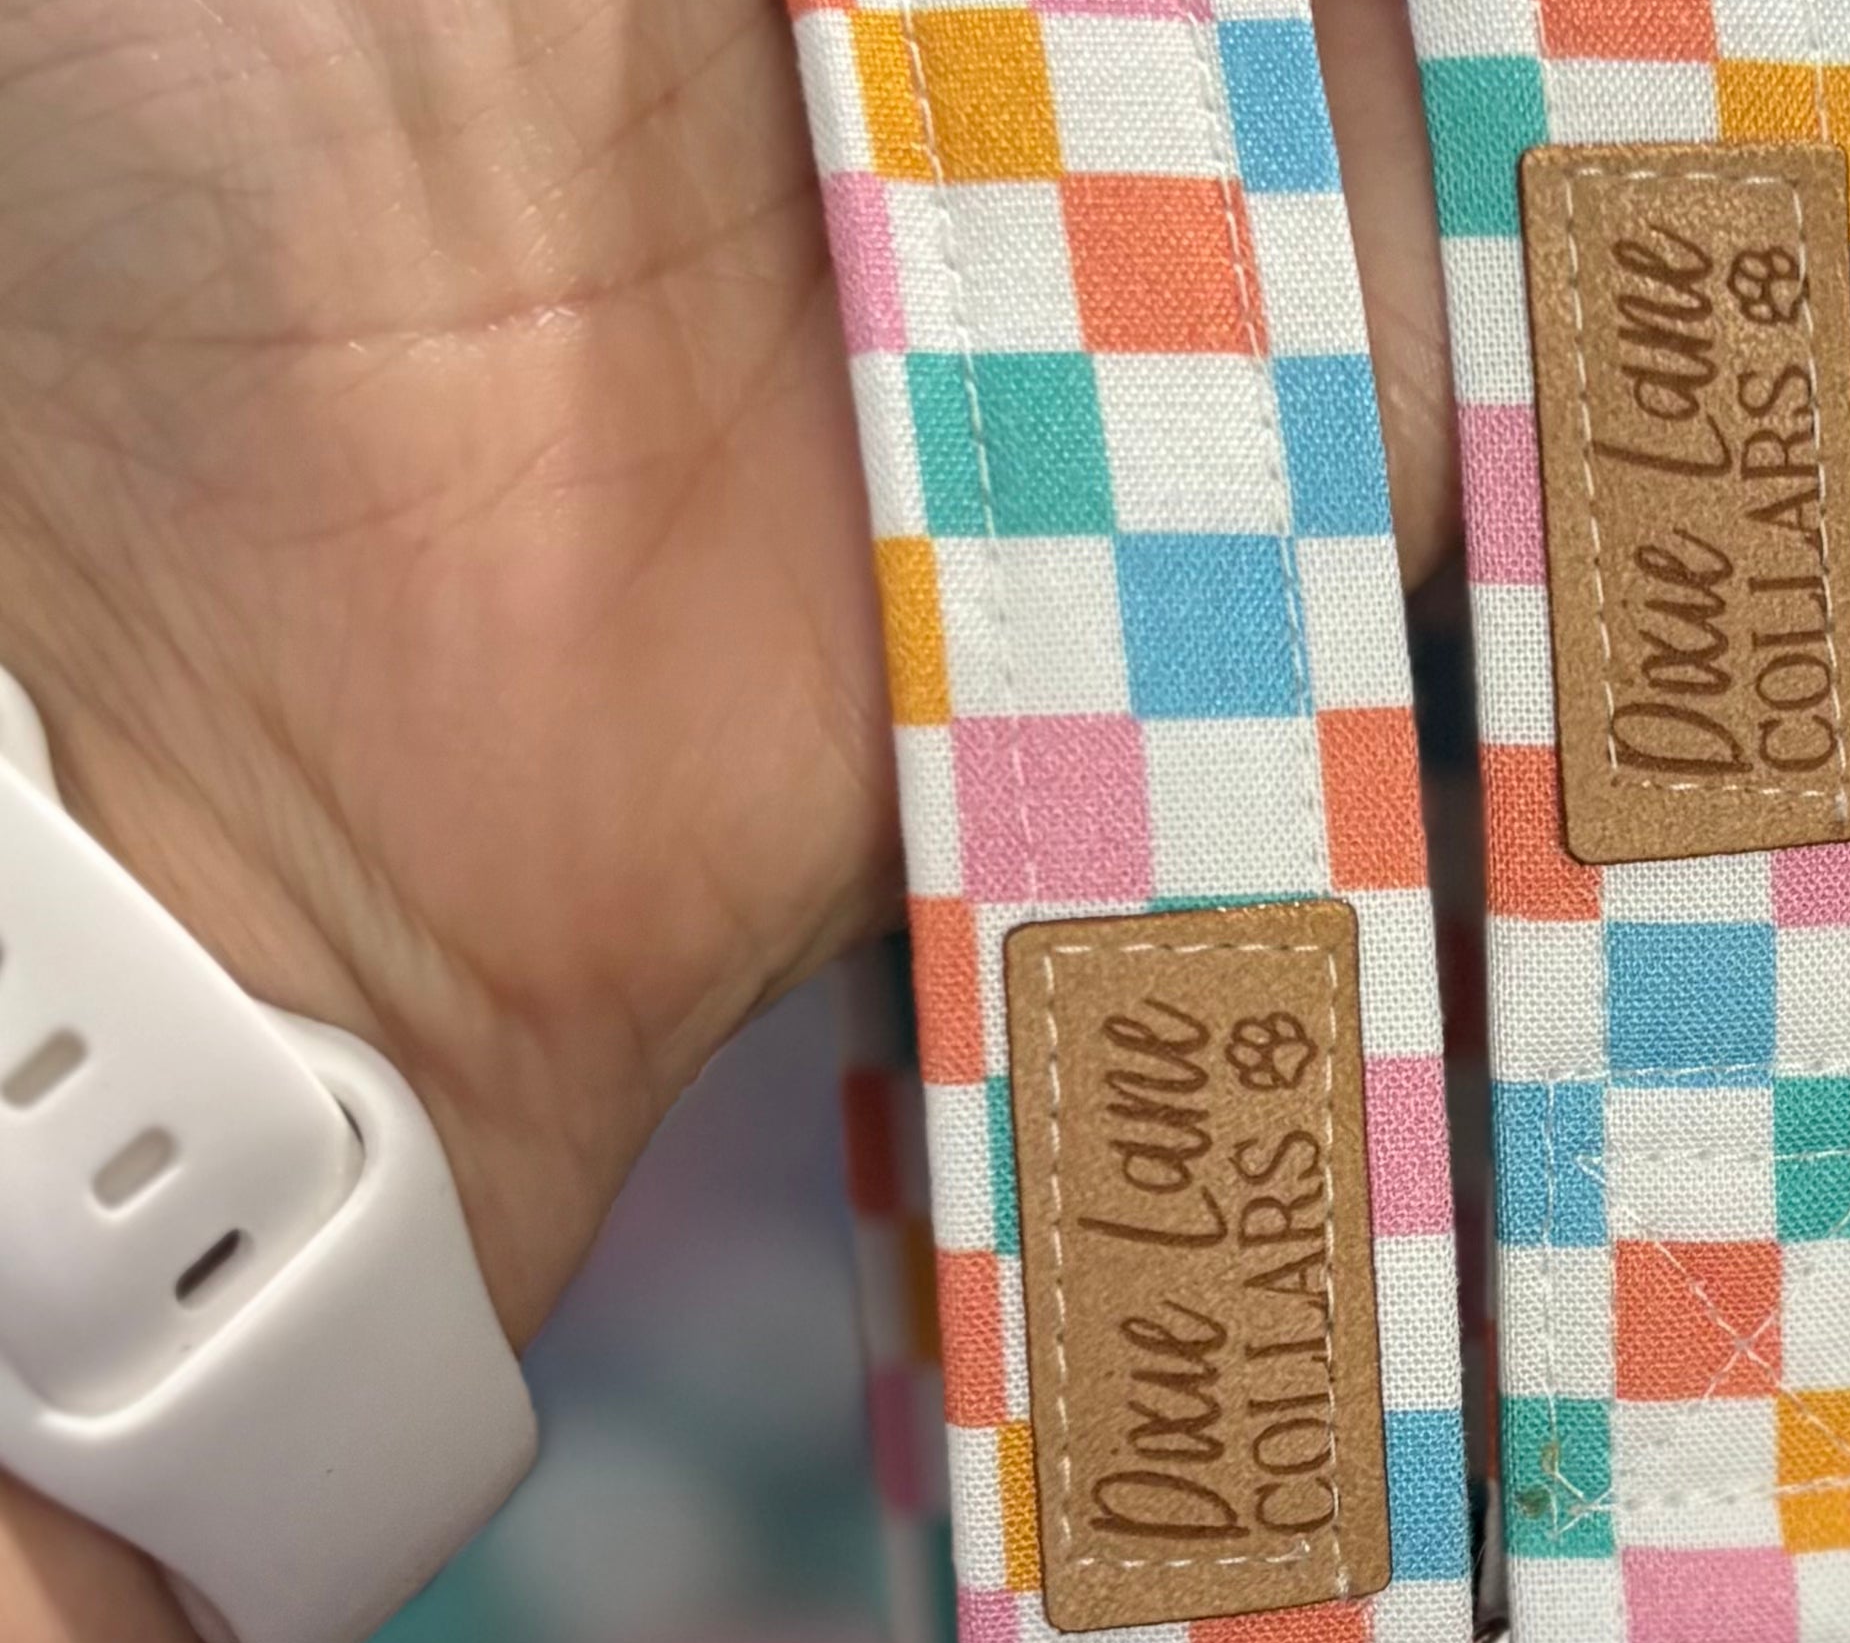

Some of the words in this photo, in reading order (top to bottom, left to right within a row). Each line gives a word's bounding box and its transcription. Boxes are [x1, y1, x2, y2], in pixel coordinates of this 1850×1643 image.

[1592, 222, 1735, 480] Lane
[1609, 526, 1755, 775] Dixie
[1736, 362, 1840, 774] COLLARS
[1077, 997, 1230, 1250] Lane
[1087, 1298, 1251, 1541] Dixie
[1228, 1127, 1340, 1537] COLLARS
